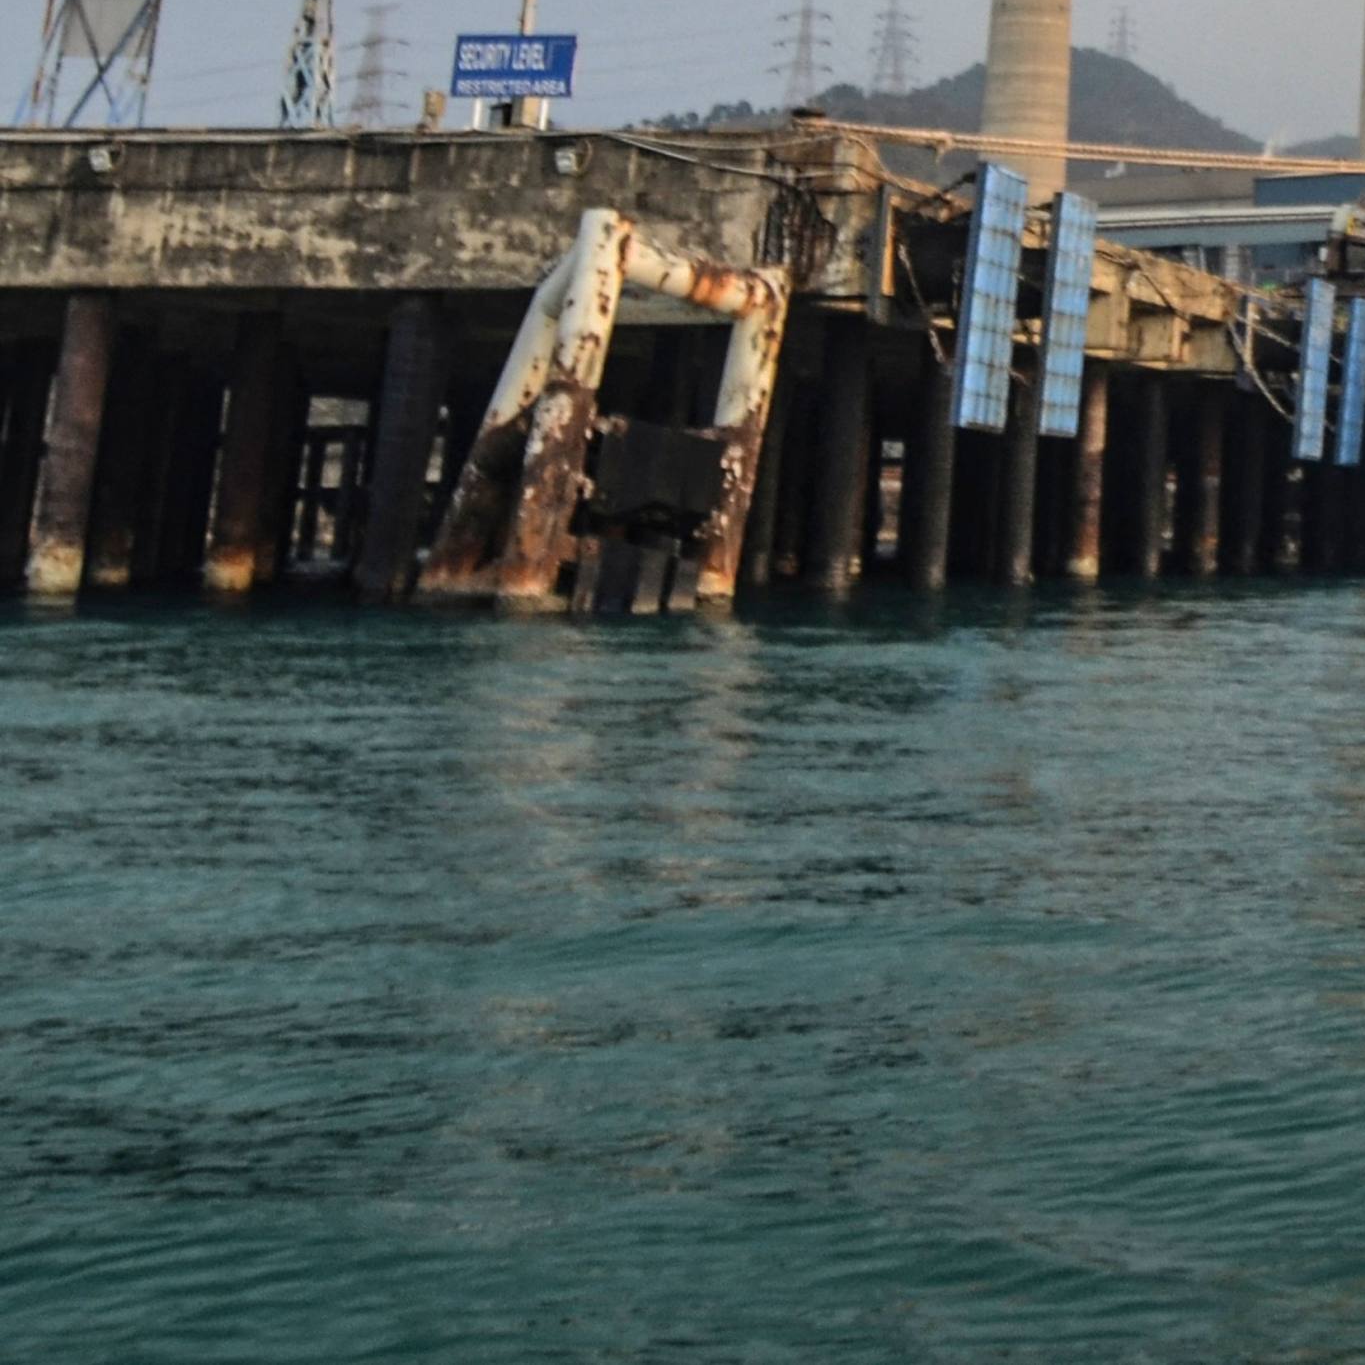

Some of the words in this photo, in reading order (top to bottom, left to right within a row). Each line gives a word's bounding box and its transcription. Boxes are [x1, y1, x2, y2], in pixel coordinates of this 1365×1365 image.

[459, 43, 511, 70] SECURITY
[512, 43, 545, 70] LEVEL
[456, 79, 531, 95] RESTRICTED
[533, 80, 567, 95] AREA
